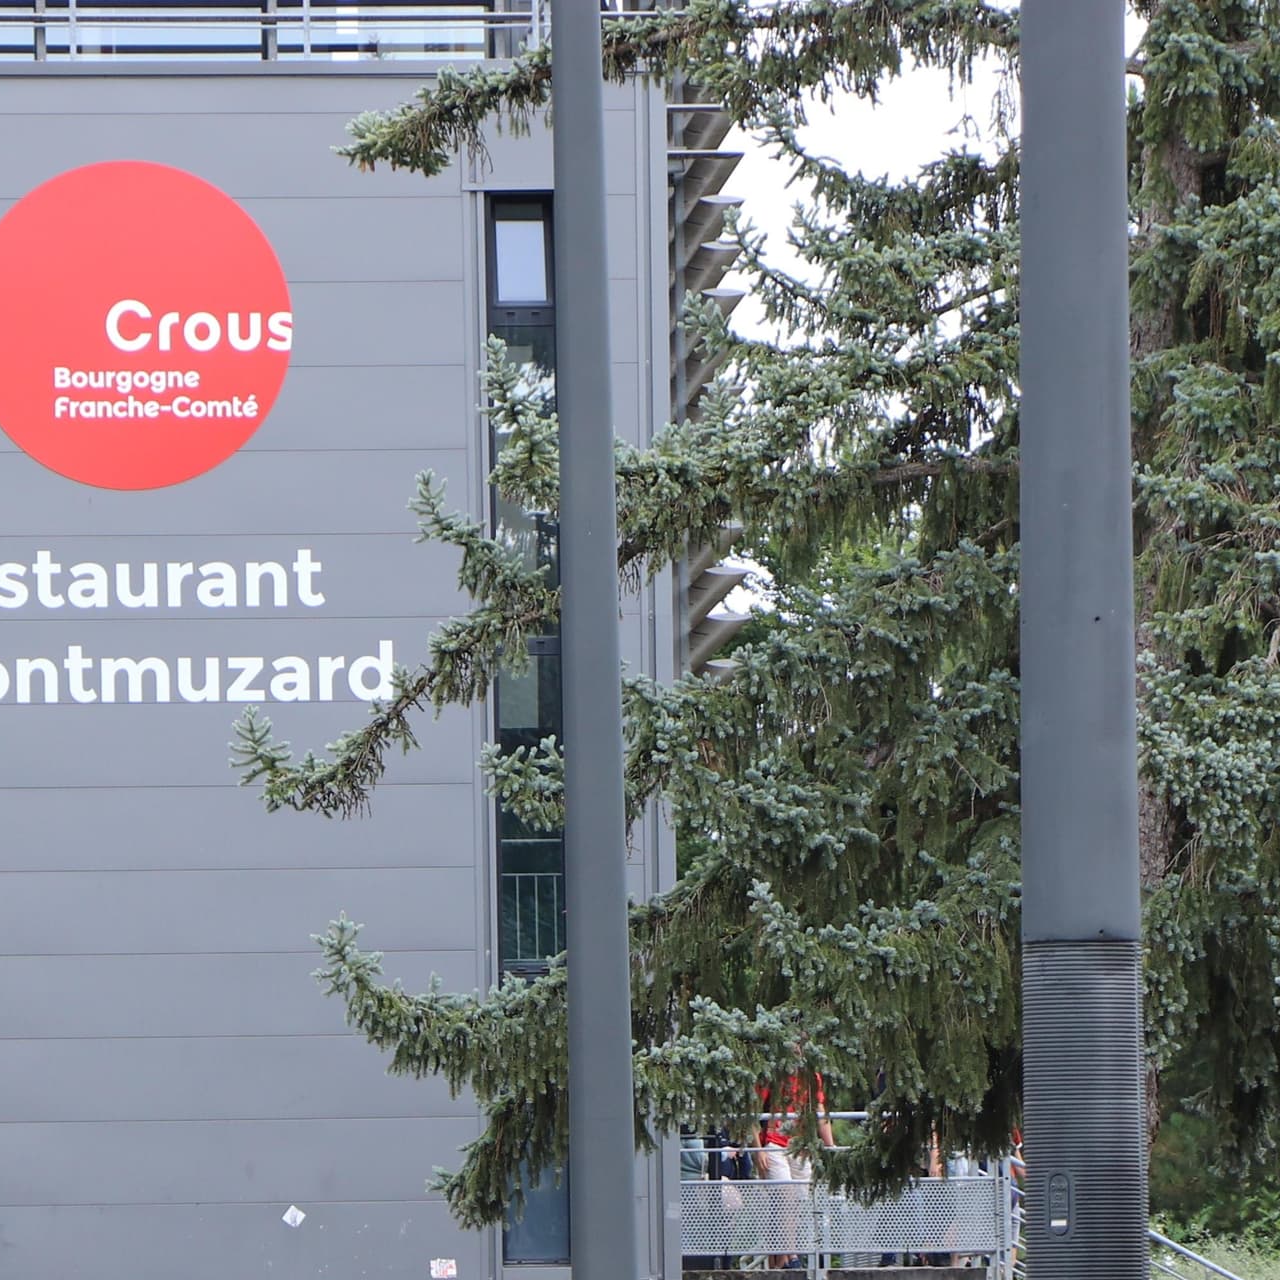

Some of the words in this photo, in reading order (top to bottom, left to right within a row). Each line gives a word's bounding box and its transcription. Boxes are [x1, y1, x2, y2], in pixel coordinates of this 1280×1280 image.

[105, 299, 292, 352] Crous
[53, 366, 200, 392] Bourgogne
[54, 394, 259, 418] Franche-Comté
